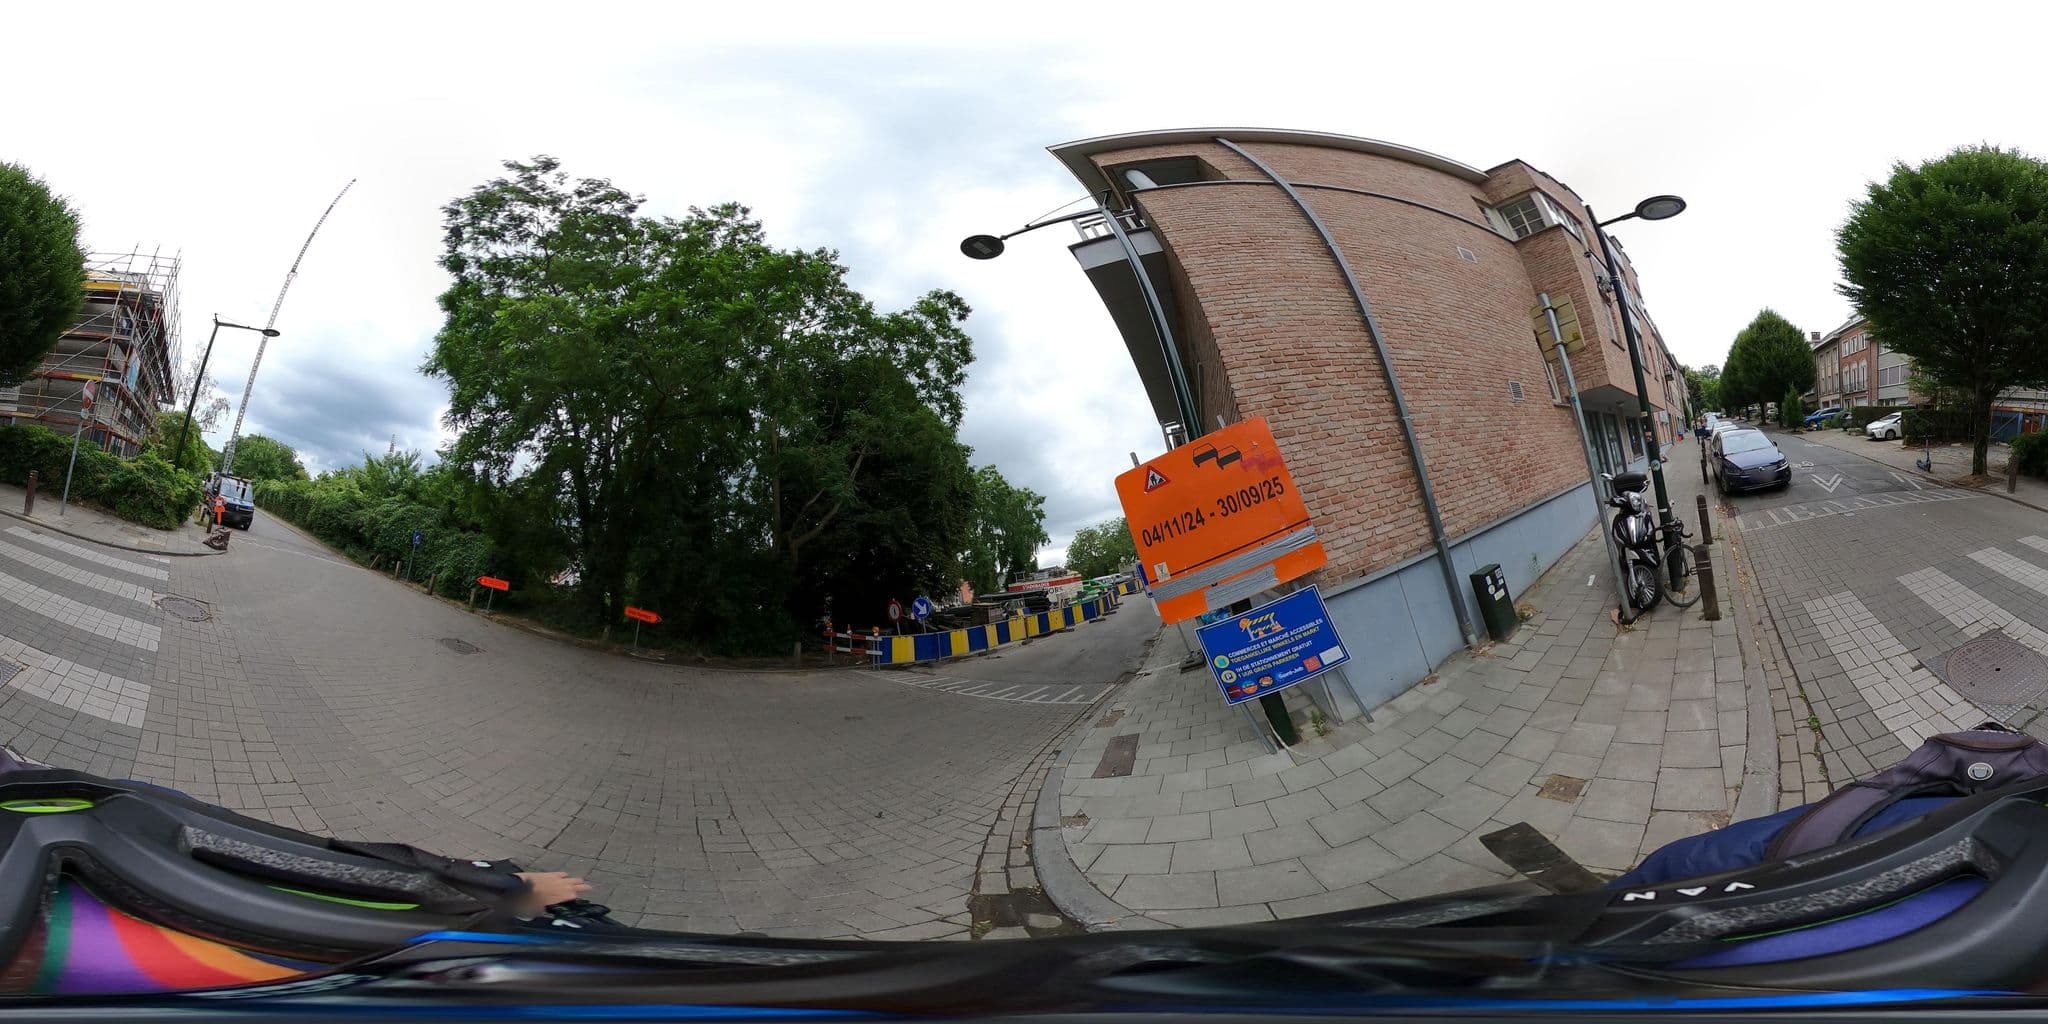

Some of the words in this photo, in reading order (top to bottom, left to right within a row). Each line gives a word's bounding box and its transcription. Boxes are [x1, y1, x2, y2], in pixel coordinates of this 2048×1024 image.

[1142, 507, 1205, 548] 04/11/24
[1216, 476, 1285, 518] 30/09/25
[1228, 644, 1260, 658] COMMERCES
[1260, 640, 1269, 648] ET
[1289, 618, 1323, 635] ACCESSIBLES
[1272, 636, 1295, 650] WINKELS
[1302, 626, 1320, 638] MARKT
[1291, 640, 1313, 653] GRATUIT
